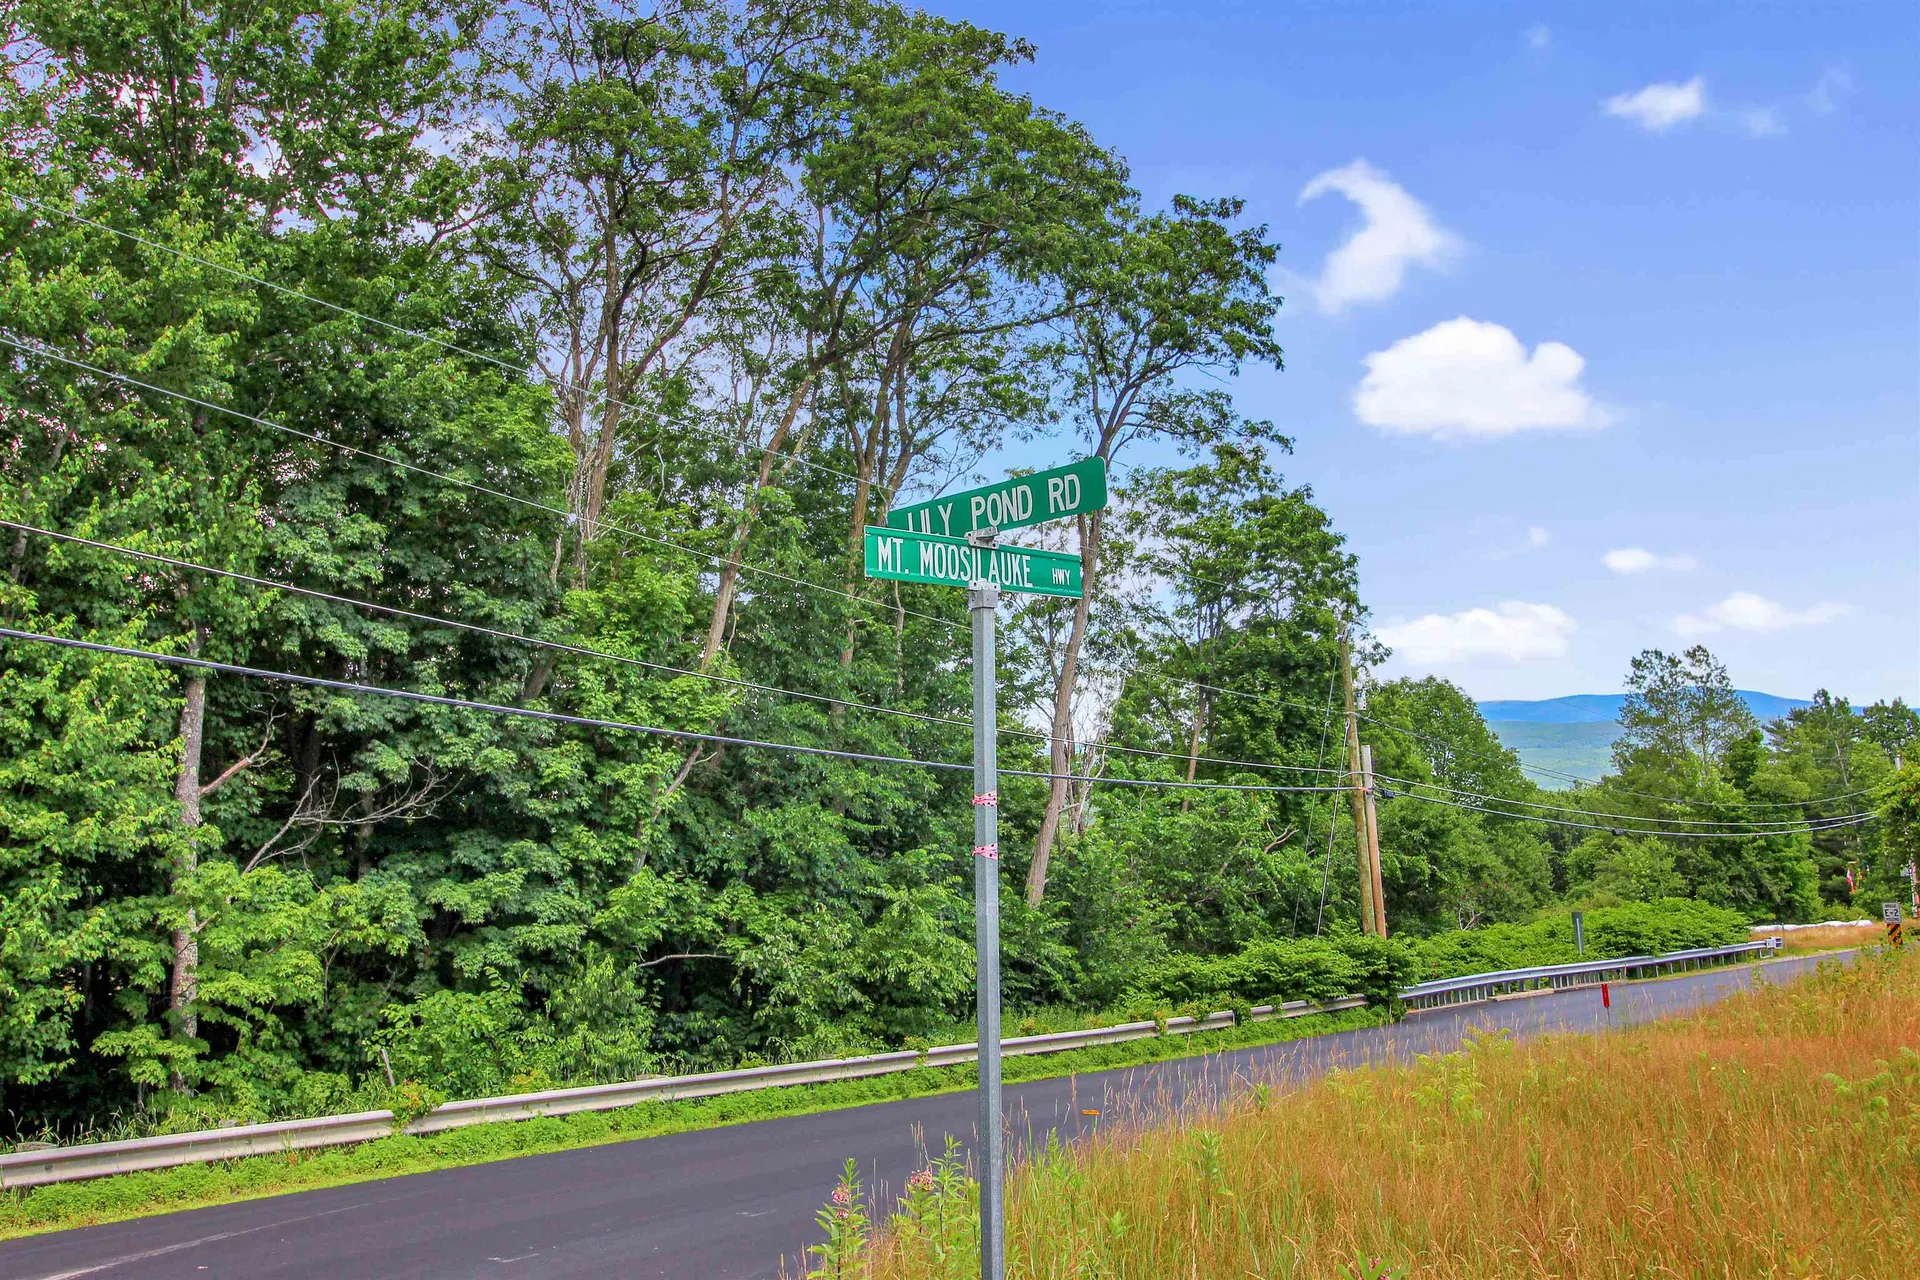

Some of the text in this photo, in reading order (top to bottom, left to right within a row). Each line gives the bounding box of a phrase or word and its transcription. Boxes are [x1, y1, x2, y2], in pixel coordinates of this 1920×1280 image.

[908, 473, 1081, 536] LILY POND RD
[877, 536, 1071, 588] MT. MOOSILAUKE HWY
[1884, 908, 1899, 917] E-2
